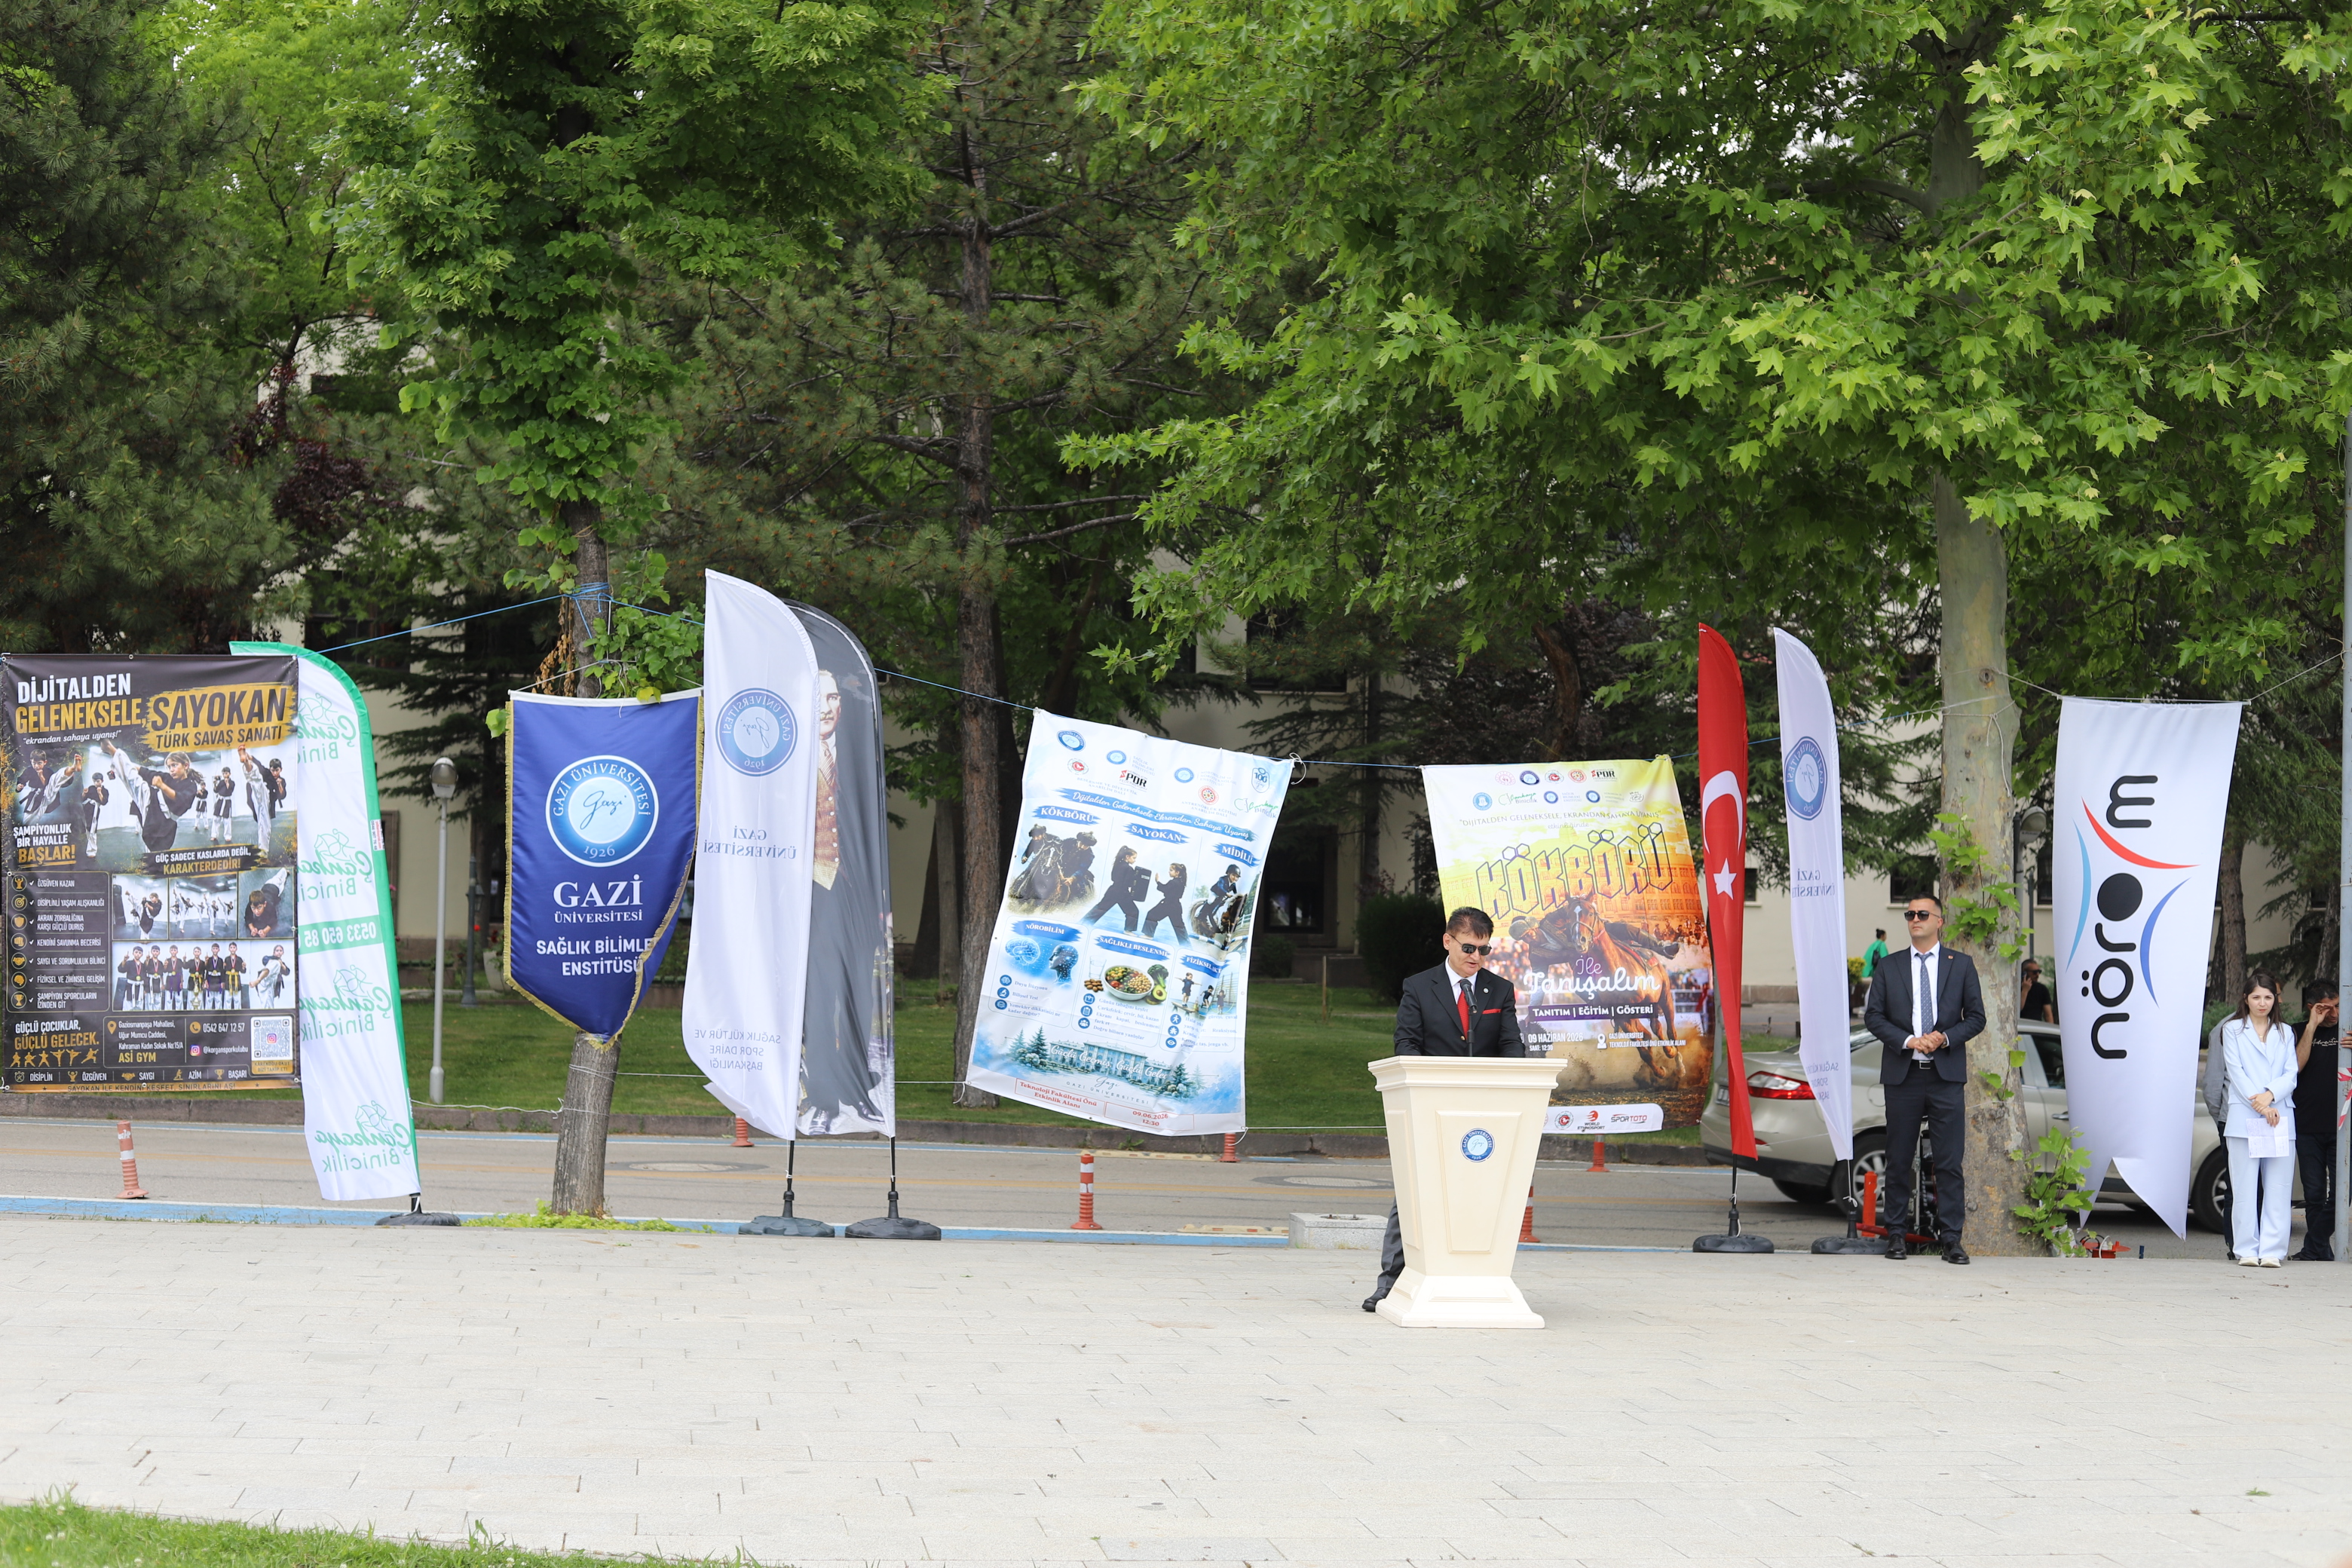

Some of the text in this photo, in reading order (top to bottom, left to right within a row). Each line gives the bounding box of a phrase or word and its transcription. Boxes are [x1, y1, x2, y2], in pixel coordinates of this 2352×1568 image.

[17, 672, 131, 704] DİJİTALDEN
[15, 698, 147, 733] GELENEKSELE,
[151, 688, 287, 731] SAYOKAN
[63, 733, 90, 743] sahaya
[156, 725, 282, 749] TÜRK SAVAŞ SANATI
[553, 761, 651, 816] GAZİ ÜNİVERSİTESİ
[1040, 807, 1094, 823] KÖKBÖRÜ
[1073, 792, 1110, 807] Dijitalden
[1112, 800, 1153, 818] Geleneksele
[1154, 813, 1193, 824] Ekrandan
[1194, 818, 1223, 831] Sahaya
[1607, 811, 1635, 819] SAHAYA
[13, 822, 72, 837] ŞAMPİYONLUK
[1132, 825, 1182, 842] SAYOKAN
[17, 834, 68, 847] BİR HAYALLE
[18, 844, 75, 865] BAŞLAR!
[155, 846, 251, 865] GÜÇ SADECE KASLARDA DEĞİL,
[583, 844, 616, 859] 1926
[163, 857, 241, 874] KARAKTERDEDİR!
[1476, 822, 1673, 920] KÖKBÖRÜ
[37, 878, 75, 887] ÖZGÜVEN KAZAN
[553, 874, 644, 908] GAZİ
[61, 899, 76, 908] YAŞAM
[554, 908, 643, 923] ÜNİVERSİTESİ
[37, 923, 84, 932] KARŞI GÜÇLÜ DURUŞ
[1025, 923, 1065, 935] NÖROBİLİM
[536, 936, 590, 955] SAĞLIK
[1099, 936, 1168, 957] SAĞLIKLI BESLENME
[58, 957, 89, 965] SORUMLULUK
[1186, 956, 1211, 969] FİZİKSEL
[1576, 955, 1603, 975] İle
[37, 975, 57, 983] FİZİKSEL
[1523, 966, 1661, 1000] Tanışalım
[58, 1000, 66, 1009] GİT
[15, 1019, 81, 1035] GÜÇLÜ ÇOCUKLAR,
[153, 1020, 176, 1028] Mahallesi,
[203, 1022, 245, 1033] 0542 647 12 57
[14, 1031, 100, 1052] GÜÇLÜ GELECEK.
[148, 1031, 167, 1039] Caddesi,
[1528, 1031, 1583, 1043] 09 HAZİRAN 2026
[118, 1050, 156, 1063] ASİ GYM
[29, 1071, 53, 1082] DİSİPLİN
[81, 1071, 107, 1081] ÖZGÜVEN
[139, 1072, 155, 1080] SAYGI
[188, 1070, 202, 1080] AZİM
[228, 1070, 247, 1080] BAŞARI
[1020, 1082, 1097, 1107] Teknoloji Fakültesi Önü
[1034, 1092, 1080, 1108] Etkinlik Alanı
